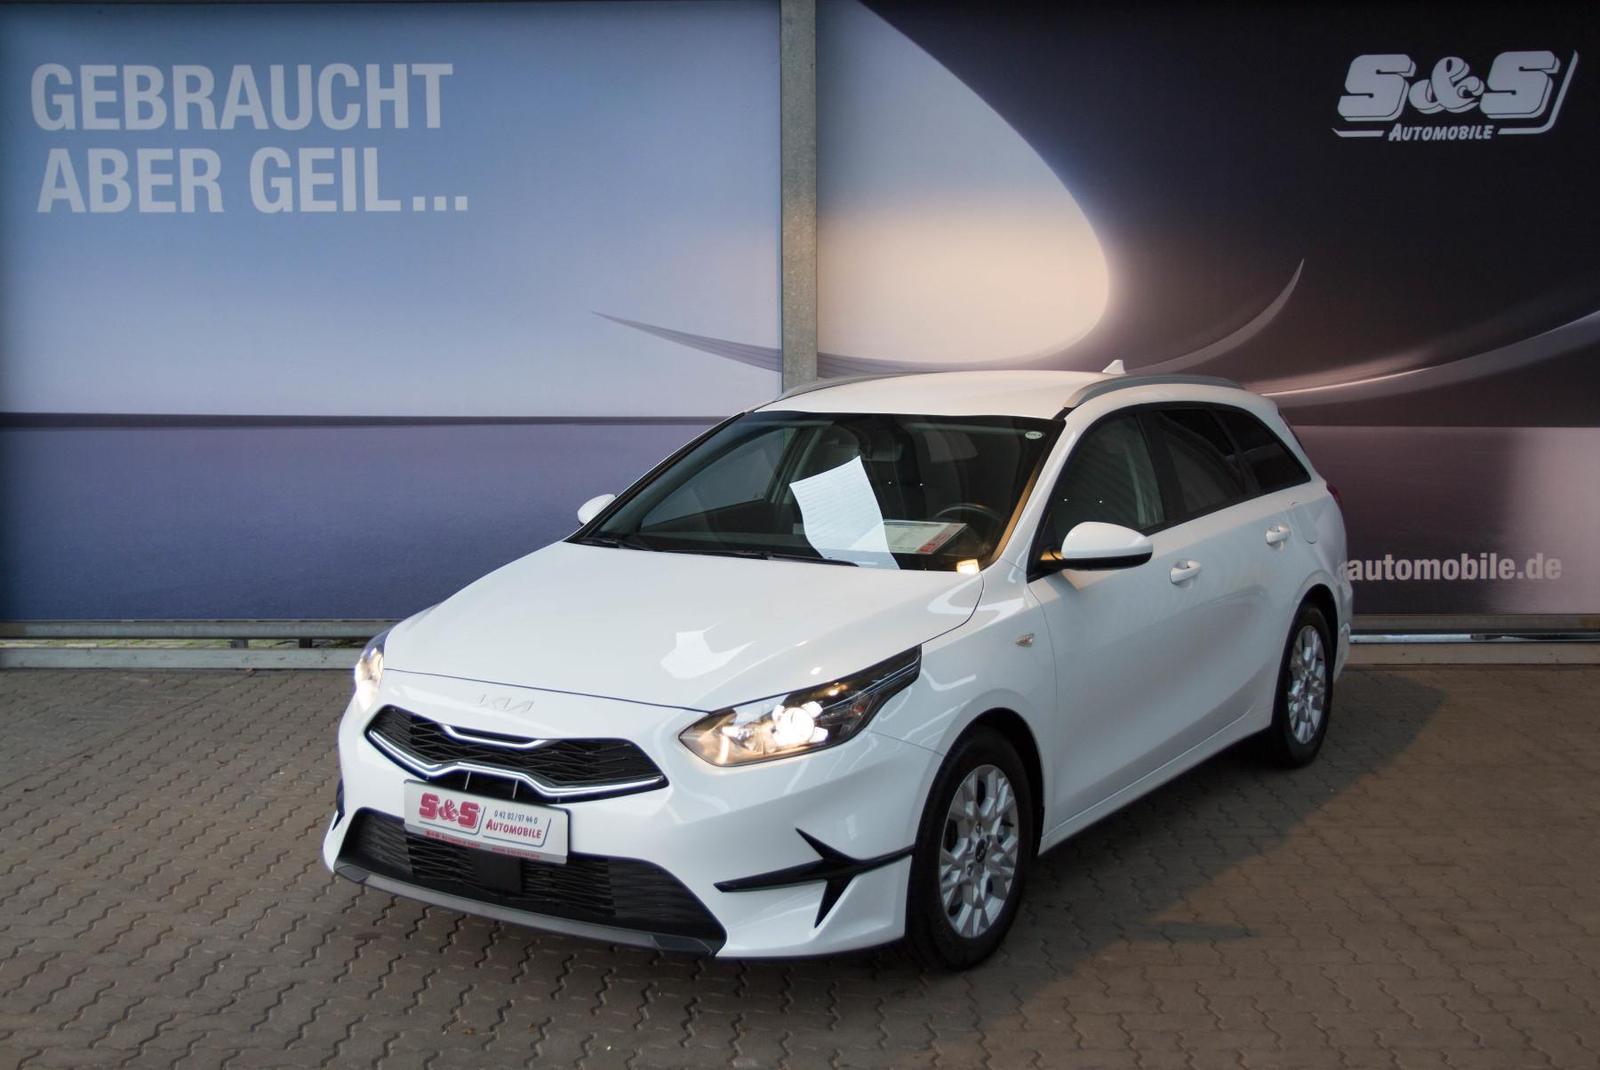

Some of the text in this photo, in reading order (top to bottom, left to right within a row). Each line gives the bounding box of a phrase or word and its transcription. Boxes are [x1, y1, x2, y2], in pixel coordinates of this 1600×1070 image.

[30, 63, 454, 131] GEBRAUCHT
[1337, 50, 1561, 122] S&S
[36, 146, 469, 214] ABER GEIL...
[419, 792, 481, 830] S&S
